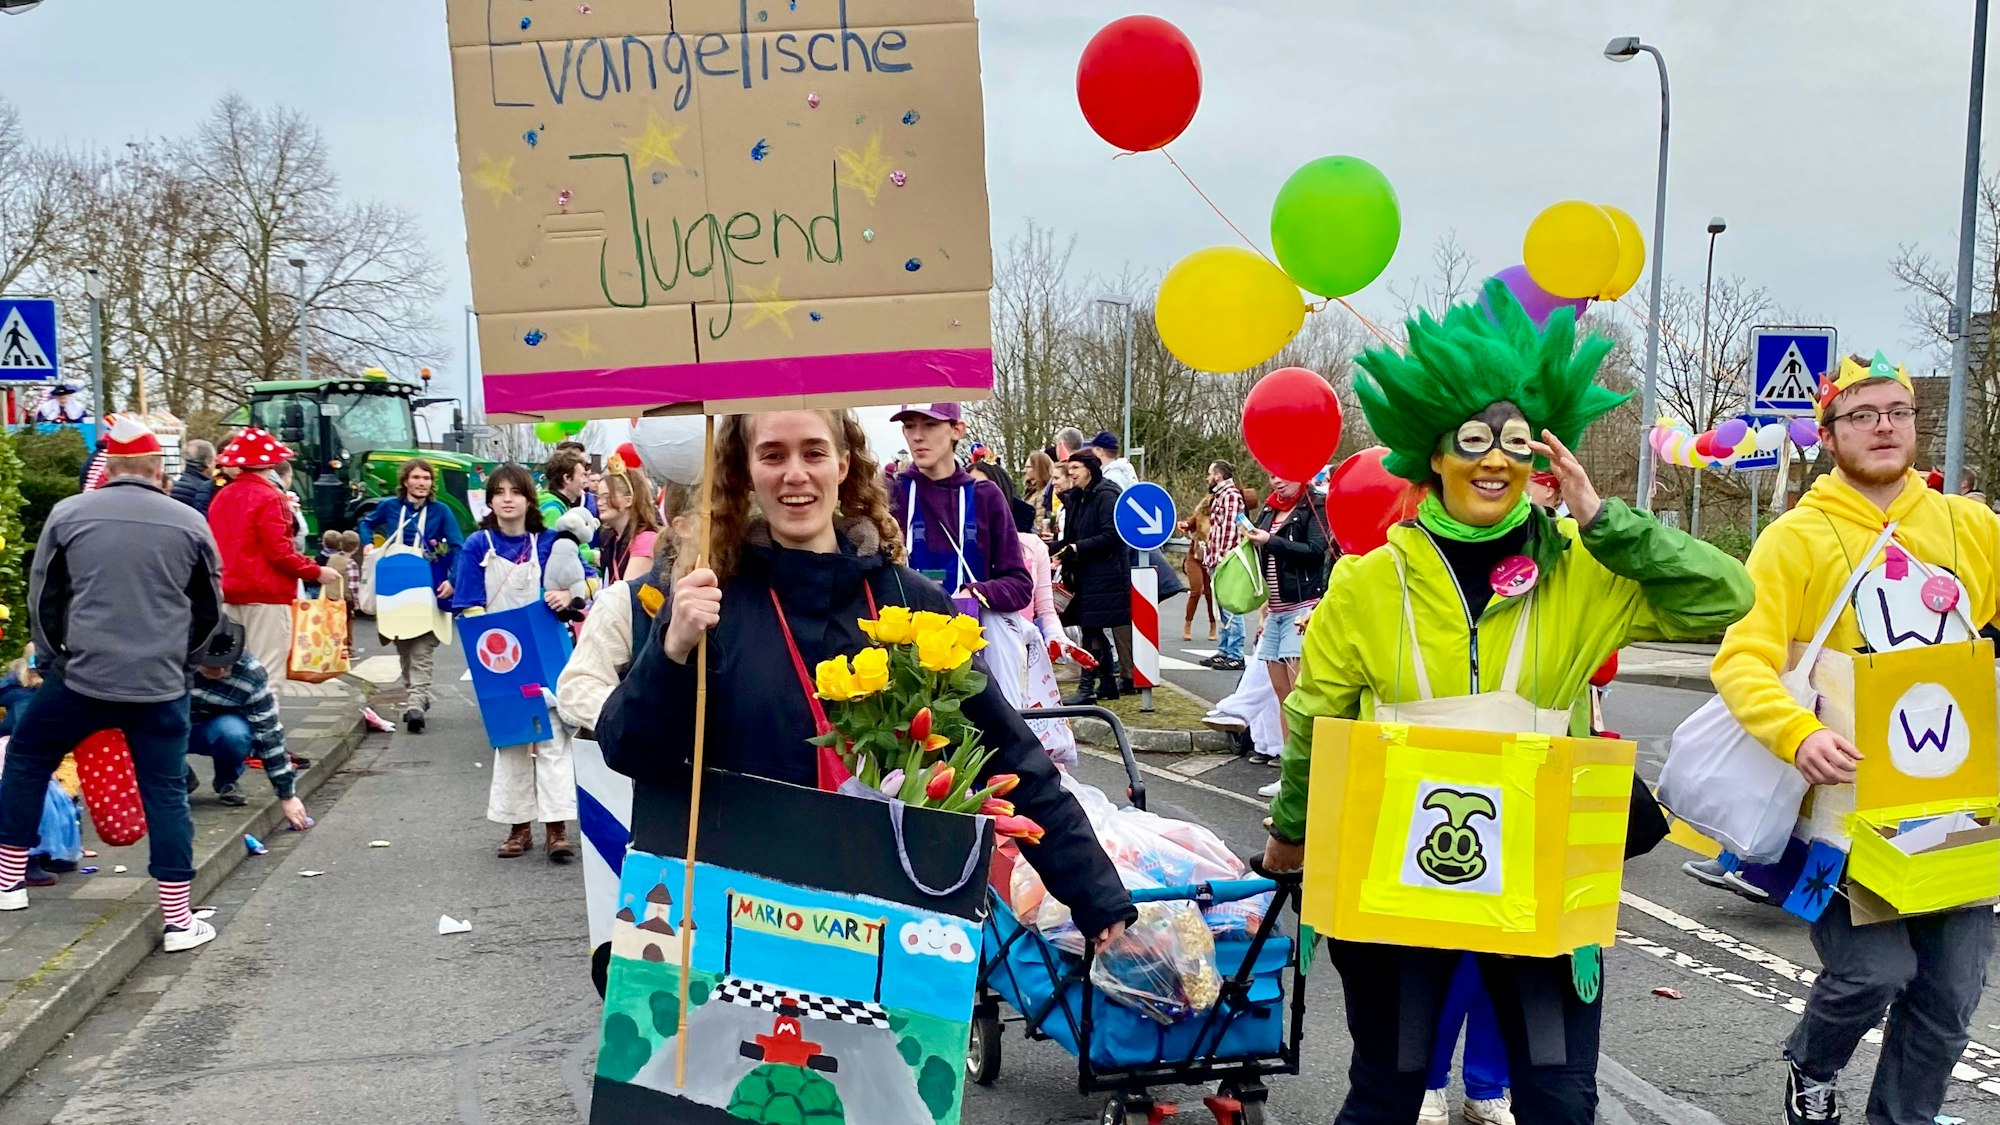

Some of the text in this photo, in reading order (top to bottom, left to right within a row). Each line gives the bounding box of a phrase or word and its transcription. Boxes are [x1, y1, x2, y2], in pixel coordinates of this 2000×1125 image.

[487, 0, 913, 111] Evangelische
[568, 153, 843, 340] Jugend
[1899, 704, 1953, 753] W
[734, 896, 879, 943] MARIO KART
[778, 1022, 796, 1036] M
